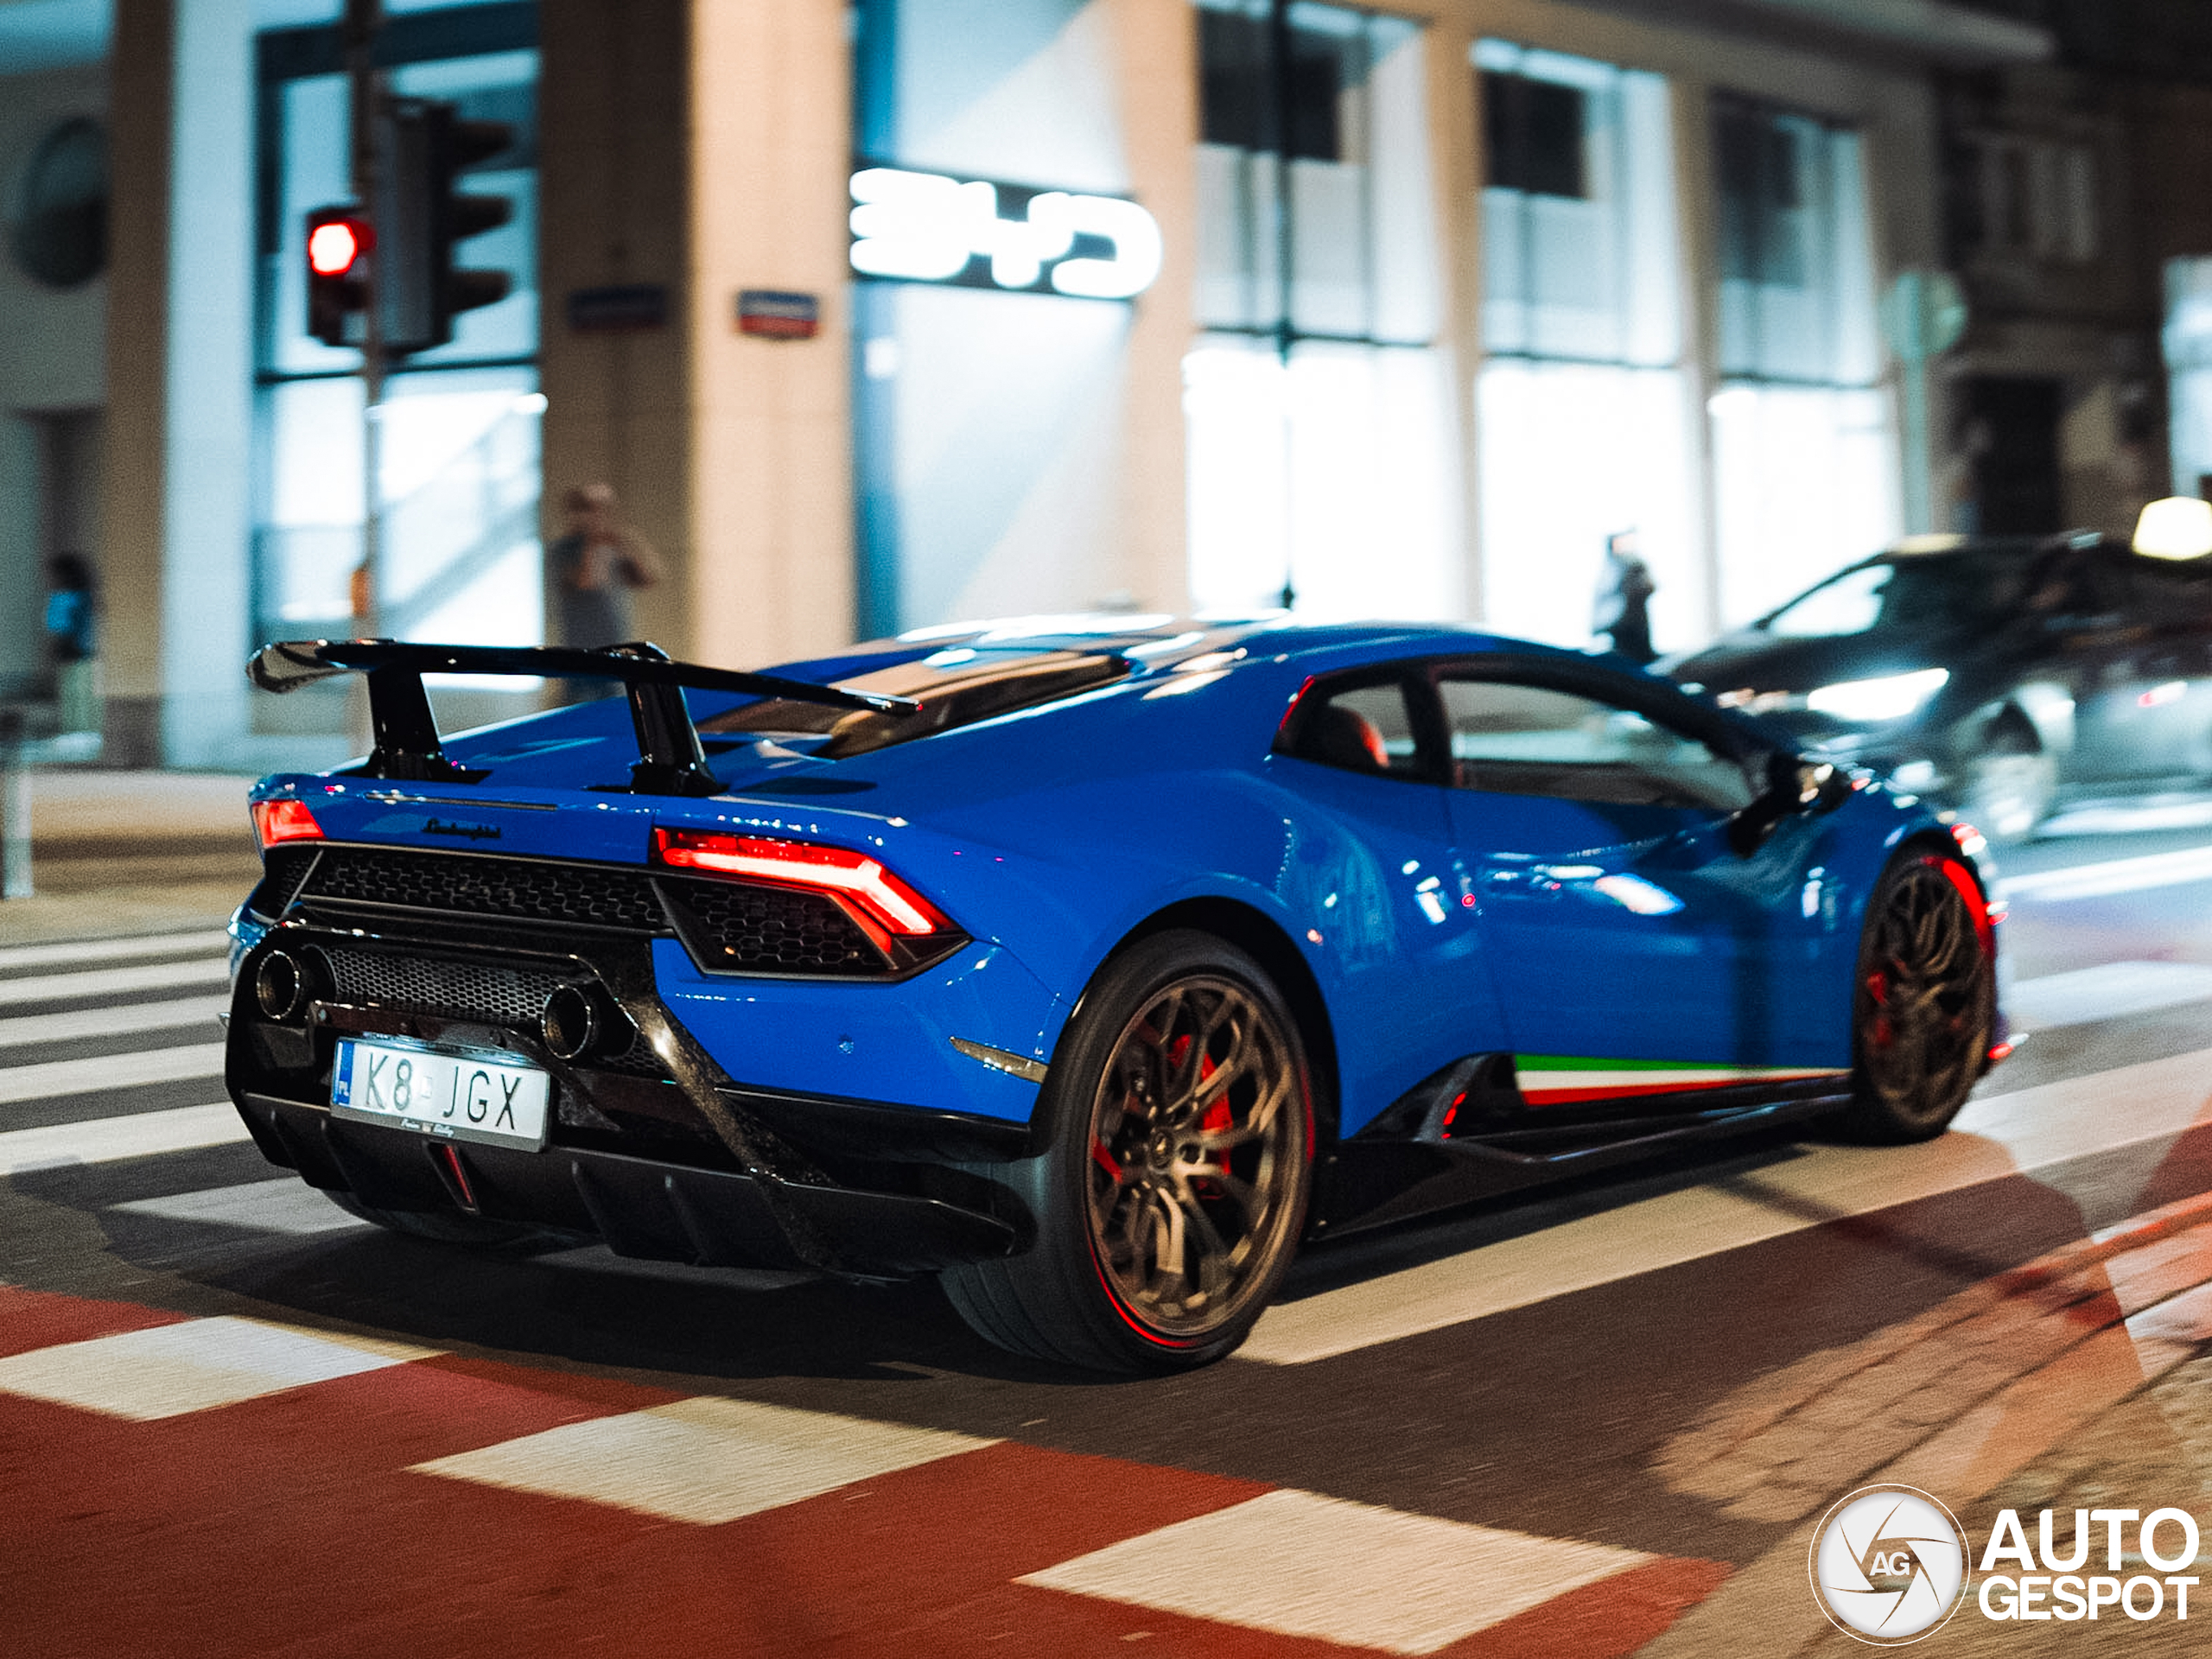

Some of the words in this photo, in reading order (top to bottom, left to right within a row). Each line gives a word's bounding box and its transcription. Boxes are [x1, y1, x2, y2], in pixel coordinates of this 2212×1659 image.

[850, 168, 1161, 299] BYD
[366, 1052, 412, 1111] K8
[442, 1065, 521, 1129] JGX
